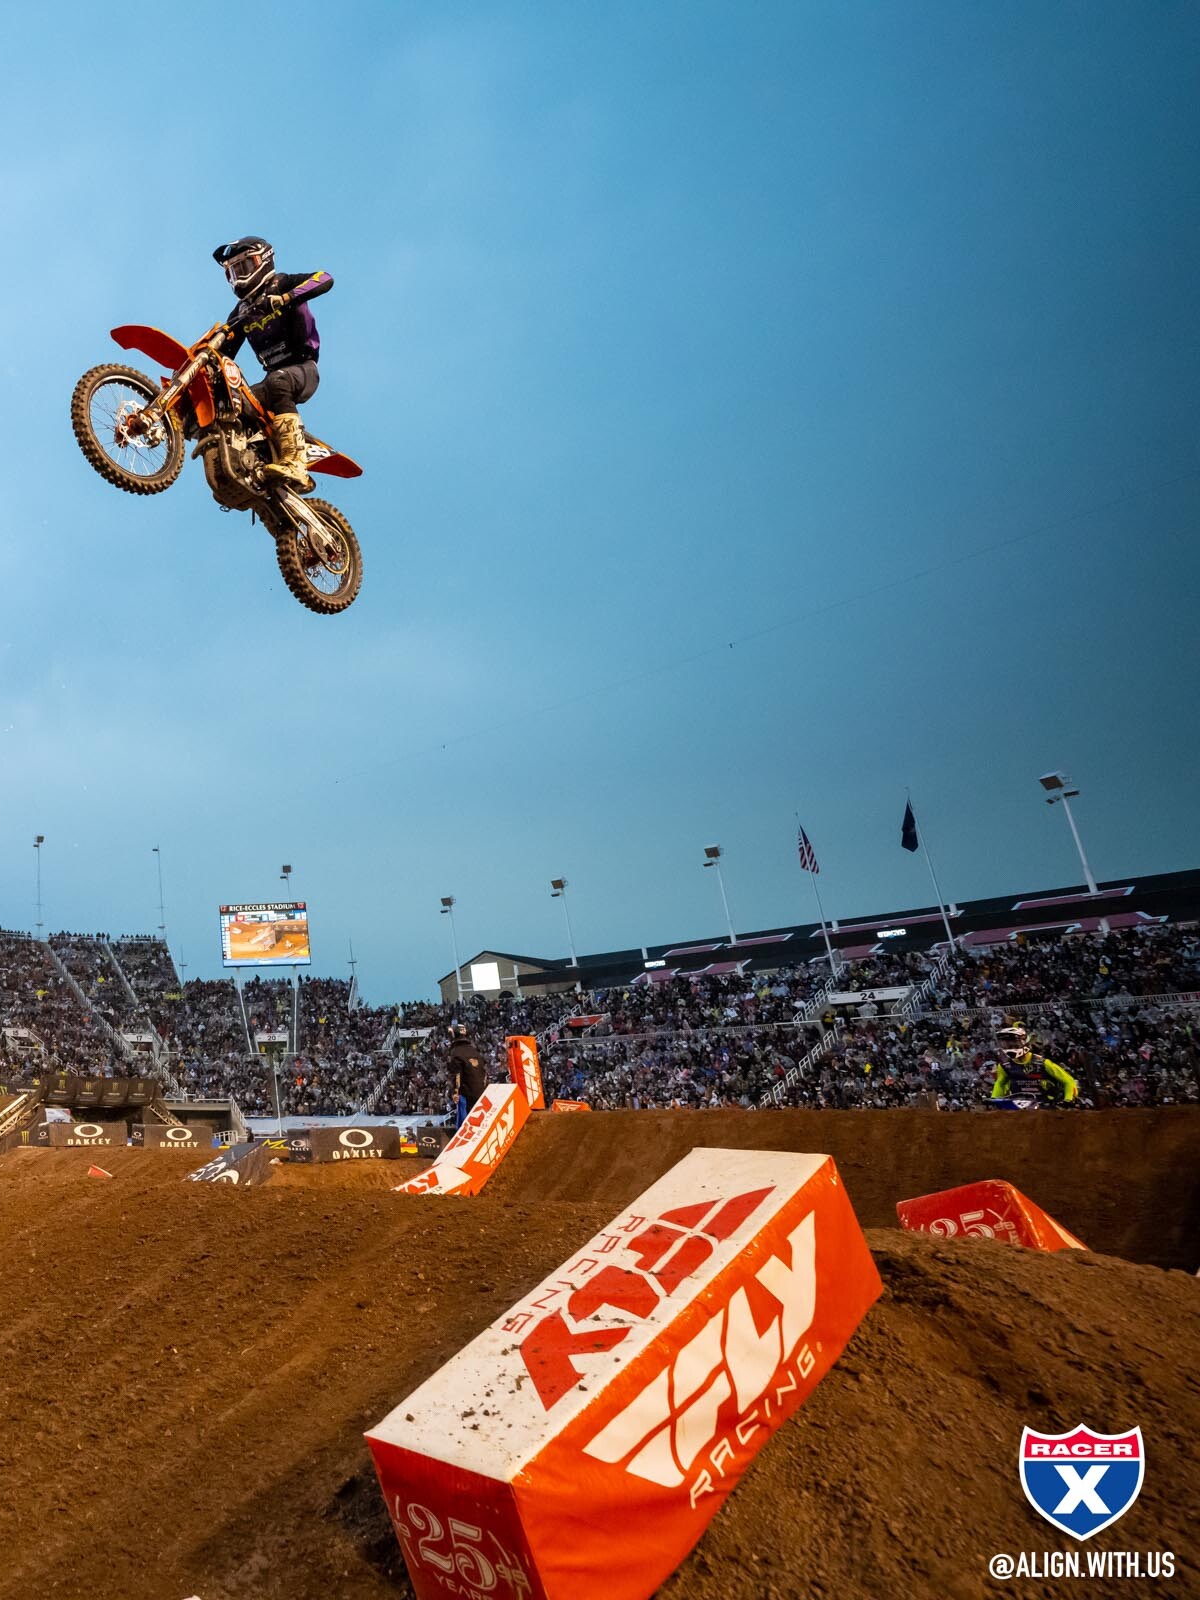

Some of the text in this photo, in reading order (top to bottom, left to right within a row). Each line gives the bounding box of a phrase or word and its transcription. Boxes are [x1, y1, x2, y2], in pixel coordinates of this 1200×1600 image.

[860, 992, 876, 1001] 24
[473, 1099, 515, 1165] FLY
[501, 1214, 650, 1334] RACING
[582, 1210, 816, 1488] FLY
[690, 1348, 818, 1509] RACING
[407, 1502, 498, 1591] 25
